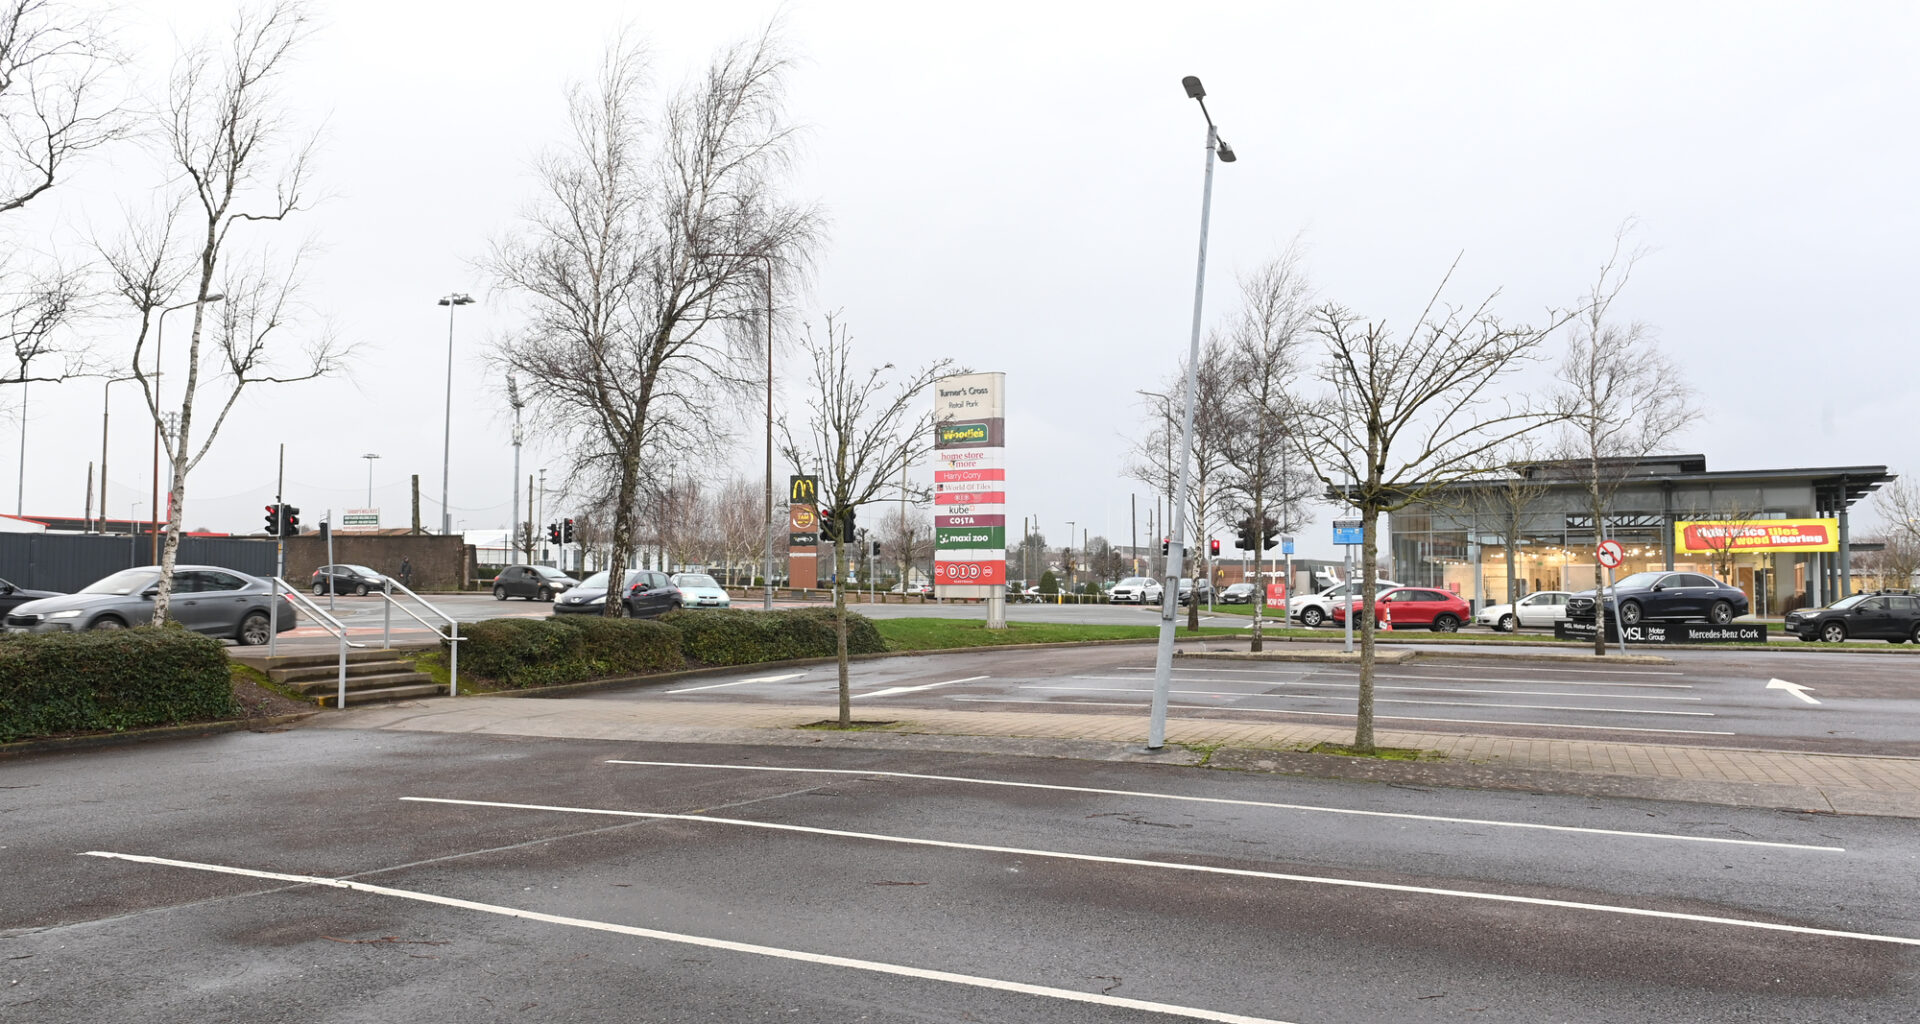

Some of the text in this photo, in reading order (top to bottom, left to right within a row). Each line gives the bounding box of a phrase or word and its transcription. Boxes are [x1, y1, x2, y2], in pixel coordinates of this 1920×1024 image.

[939, 387, 989, 397] Turner's Cross
[941, 452, 963, 460] home
[943, 471, 982, 481] Harry Corry
[948, 505, 970, 514] kube
[949, 517, 975, 525] COSTA
[1768, 527, 1799, 536] tiles
[950, 532, 971, 542] maxi
[1736, 535, 1770, 546] wood
[1771, 535, 1823, 545] flooring
[1620, 627, 1646, 640] MSL
[1688, 629, 1759, 639] Mercedes-Benz Cork
